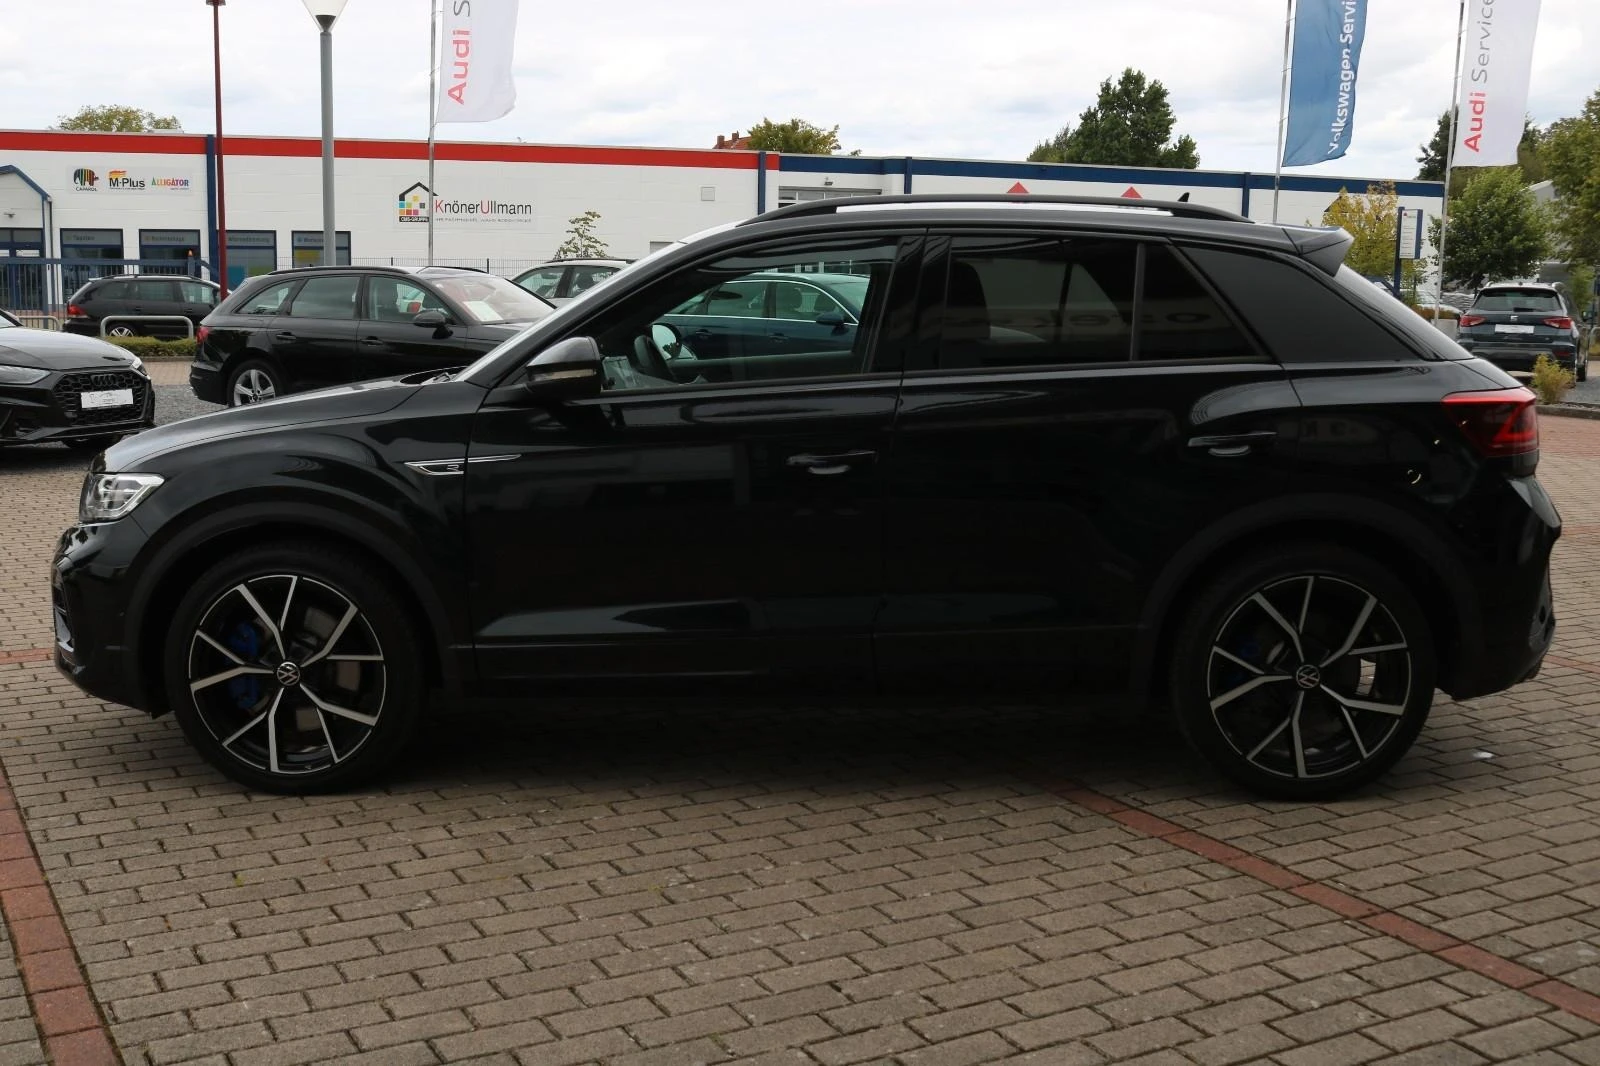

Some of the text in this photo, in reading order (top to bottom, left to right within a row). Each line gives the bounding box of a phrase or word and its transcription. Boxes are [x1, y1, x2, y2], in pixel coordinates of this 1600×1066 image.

[447, 30, 471, 105] Audi
[1327, 49, 1354, 154] Volkswagen
[1464, 92, 1486, 152] Audi
[435, 199, 532, 215] KnönerUllmann
